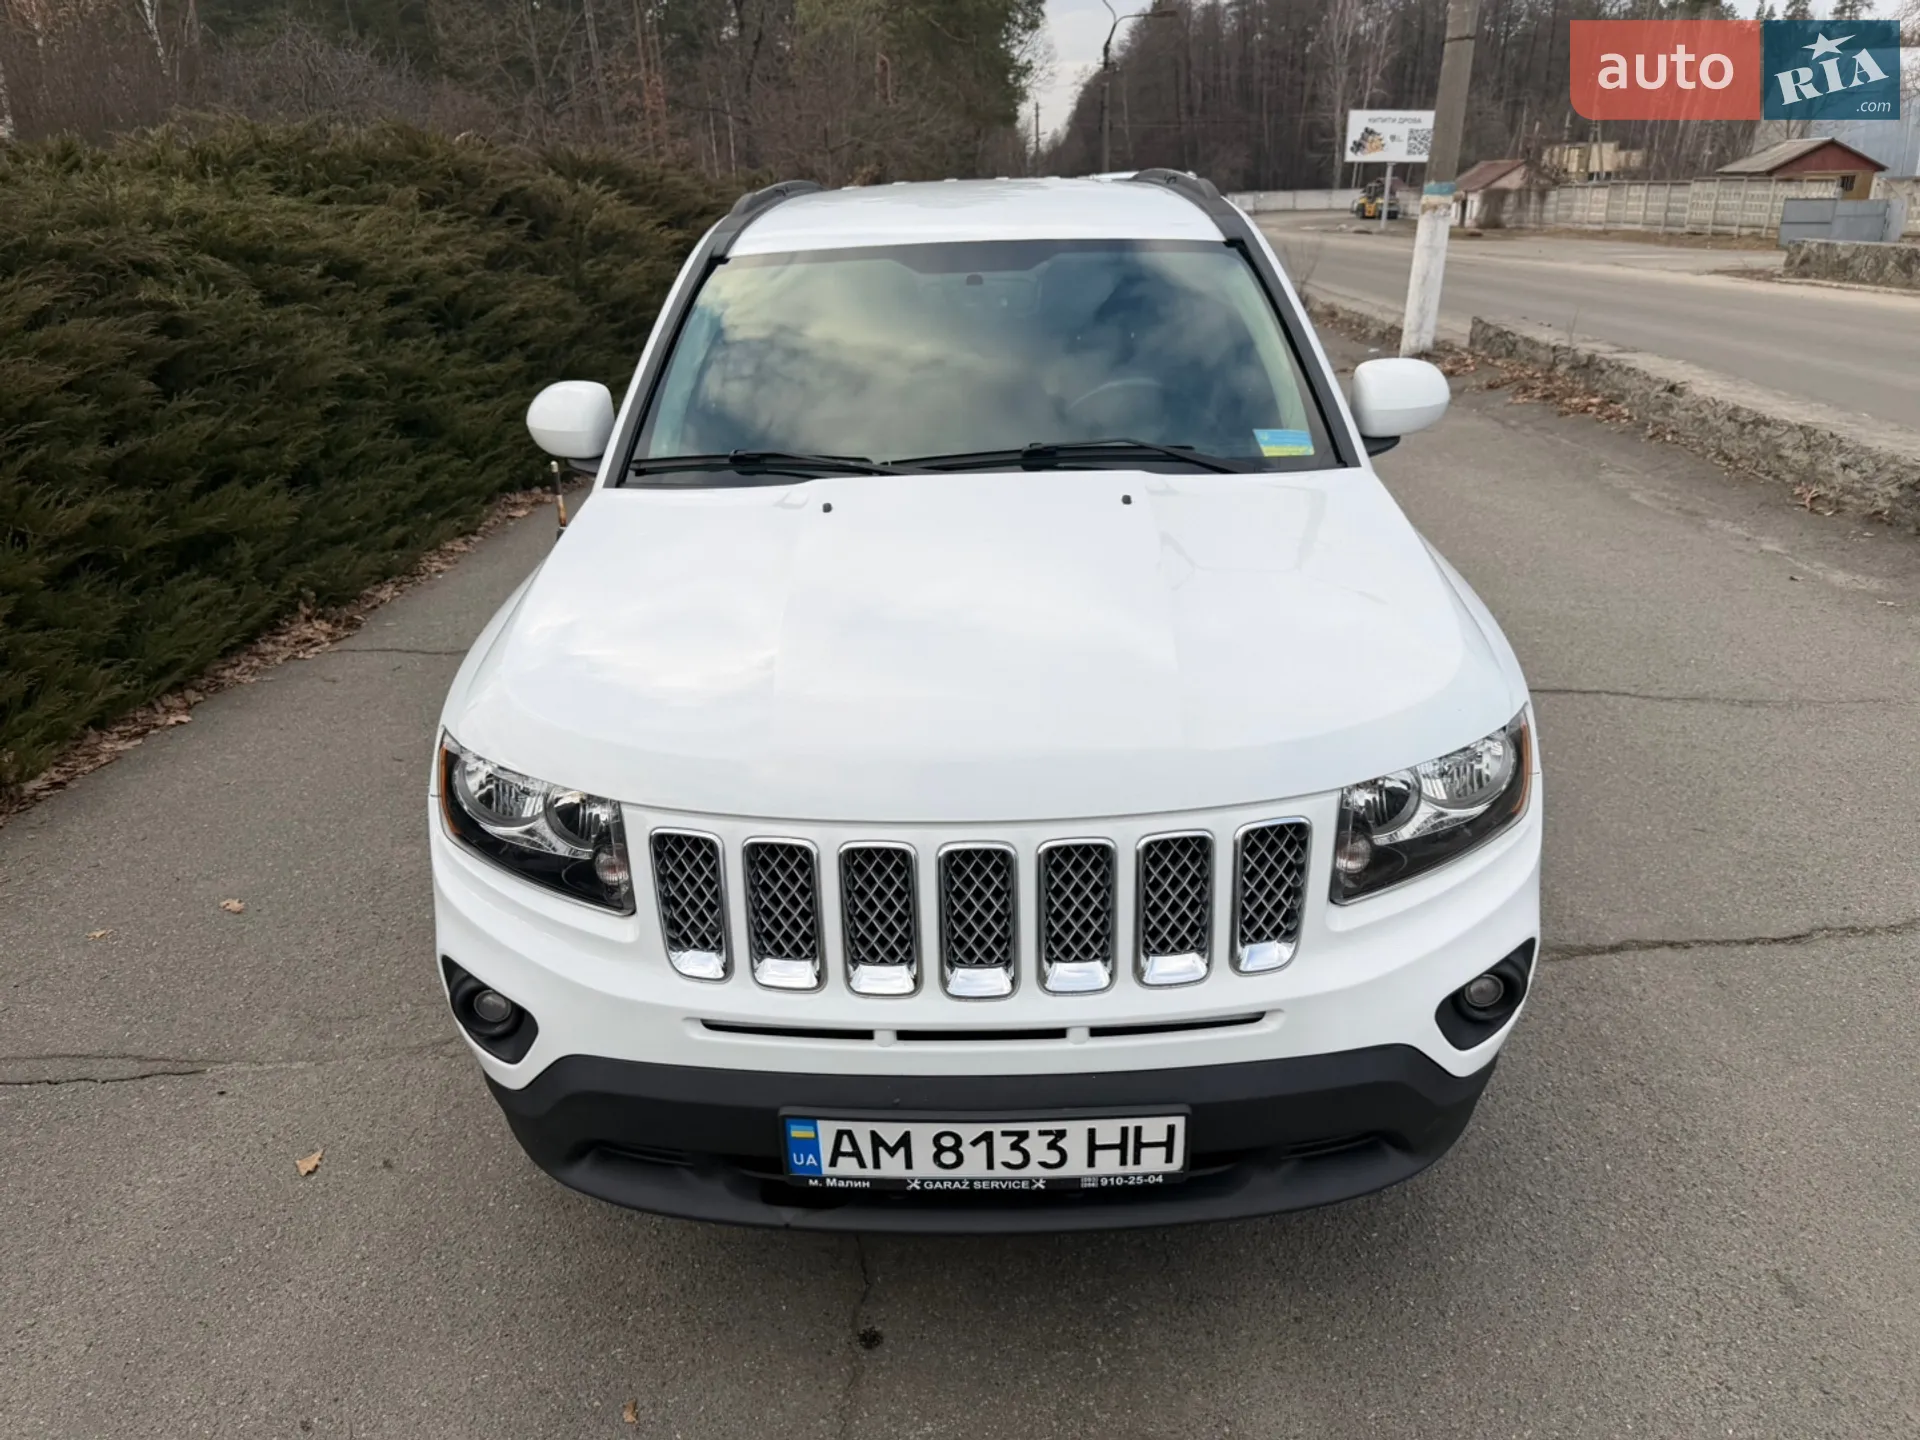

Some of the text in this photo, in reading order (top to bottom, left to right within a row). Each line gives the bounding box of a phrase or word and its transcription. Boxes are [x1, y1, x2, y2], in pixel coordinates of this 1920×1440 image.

[828, 1124, 1177, 1170] AM 8133 HH
[793, 1153, 818, 1167] UA
[808, 1178, 870, 1188] м. Малин
[973, 1180, 1030, 1189] SERVICE
[1100, 1175, 1163, 1186] 910-25-04
